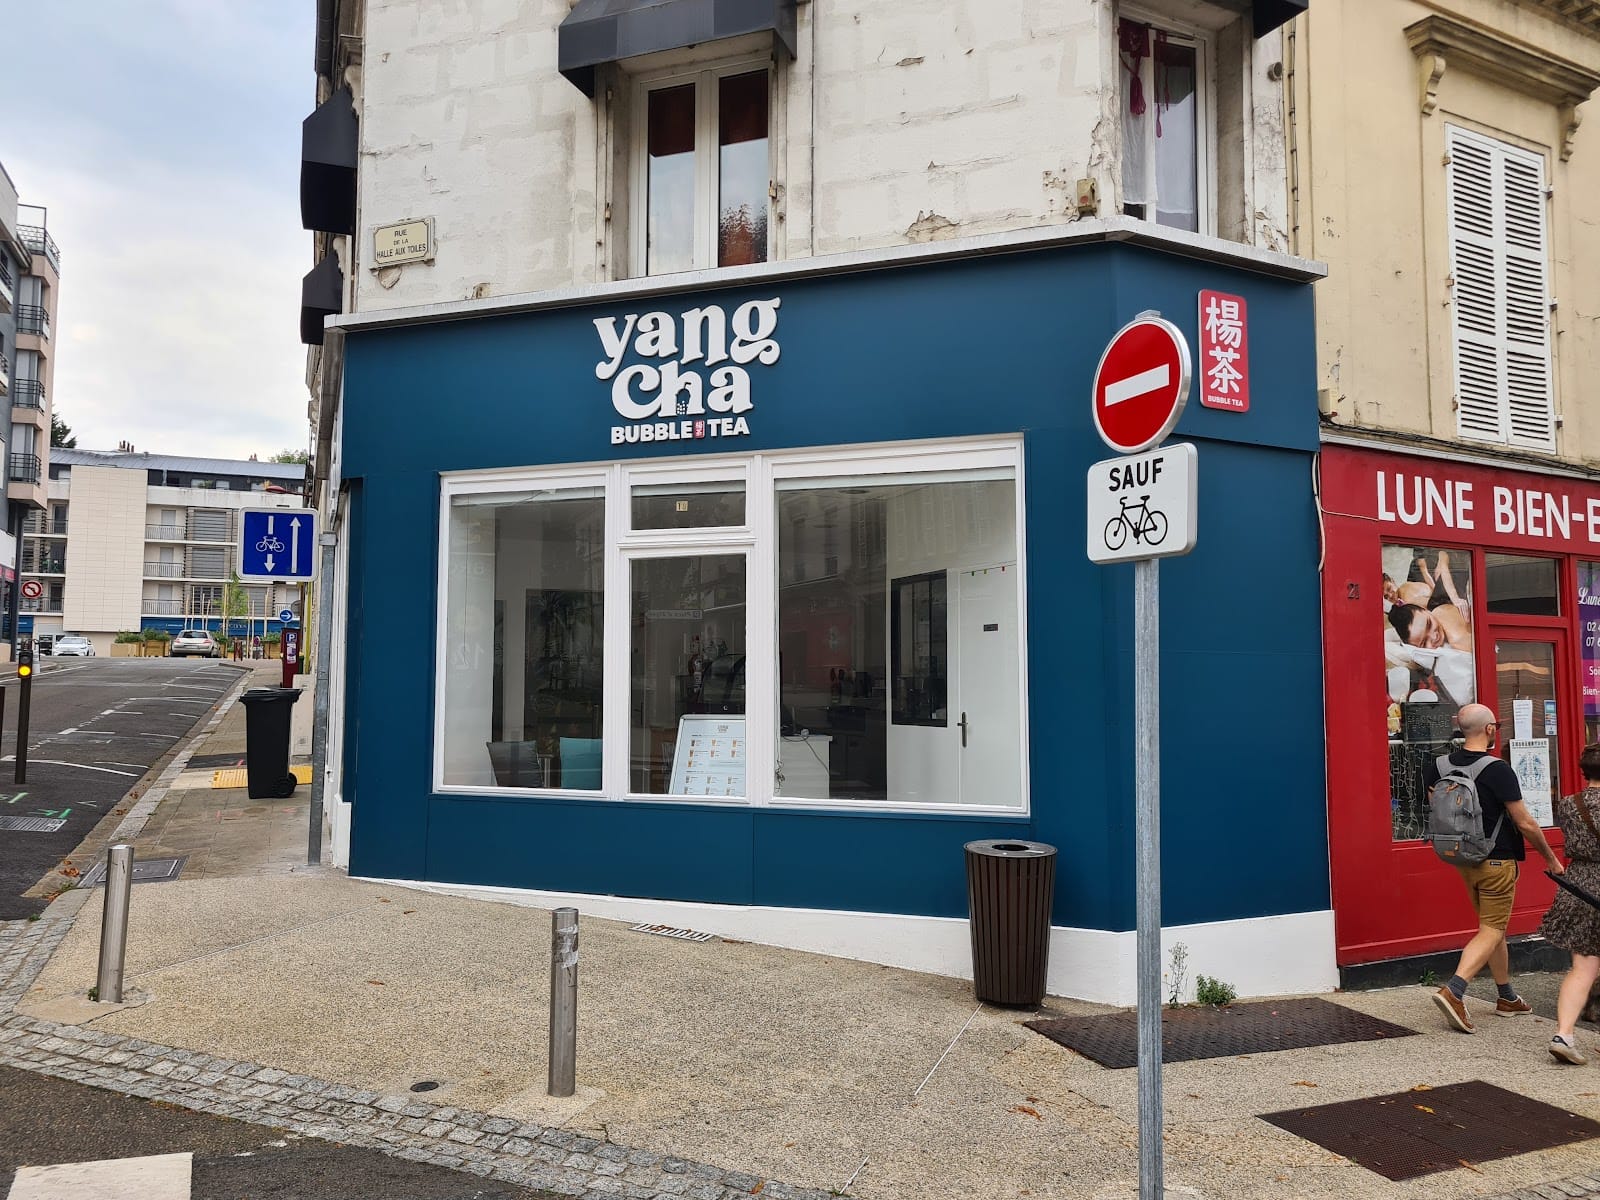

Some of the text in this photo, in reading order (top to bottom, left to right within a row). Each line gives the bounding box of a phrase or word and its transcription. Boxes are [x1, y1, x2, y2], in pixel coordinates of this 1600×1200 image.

[394, 229, 407, 237] RUE
[376, 243, 426, 258] HALLE AUX TOILES
[592, 296, 782, 380] yang
[1205, 296, 1243, 394] 楊茶
[611, 360, 754, 419] cha
[1207, 395, 1244, 407] BUBBLE TEA
[610, 421, 693, 445] BUBBLE
[707, 416, 751, 437] TEA
[1108, 457, 1164, 492] SAUF
[1376, 470, 1600, 543] LUNE BIEN-E
[1586, 621, 1597, 632] 02
[1586, 636, 1595, 647] 07
